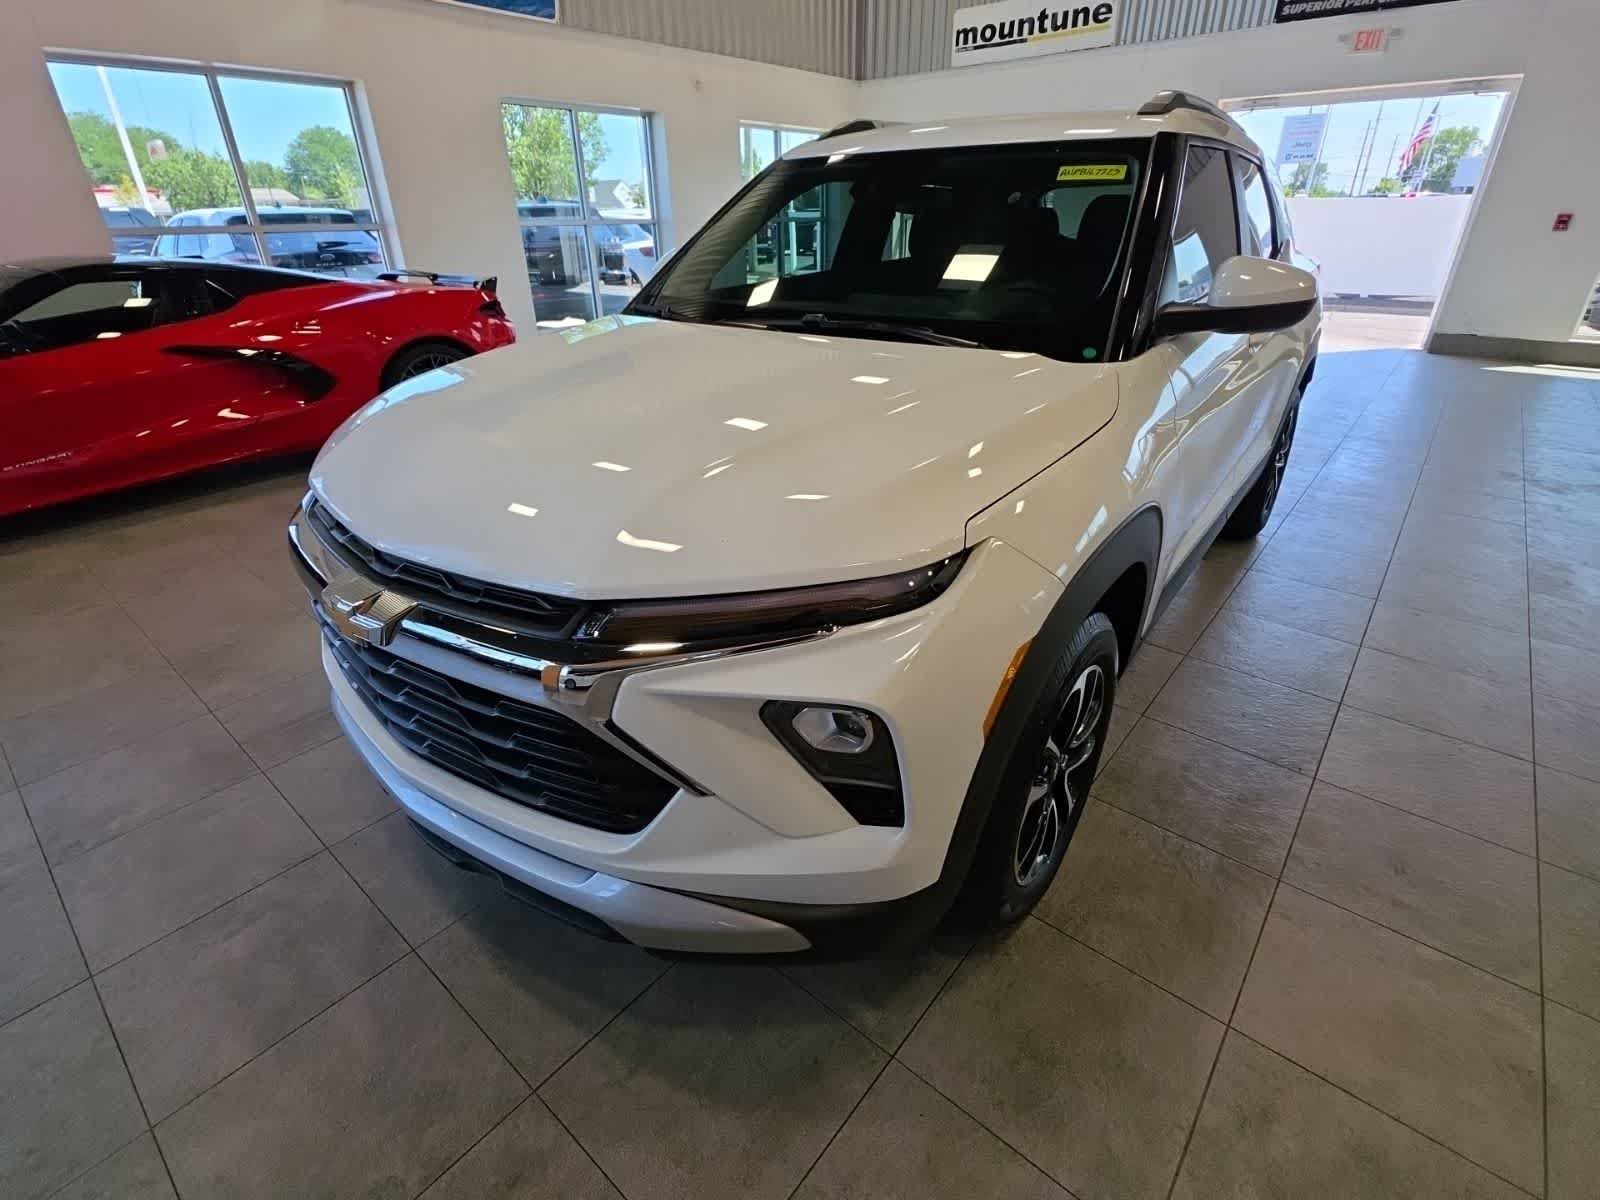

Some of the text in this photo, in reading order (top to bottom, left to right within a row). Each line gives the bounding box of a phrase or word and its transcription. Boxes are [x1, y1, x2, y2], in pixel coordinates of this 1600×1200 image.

[1281, 0, 1342, 15] SUPERIOR
[955, 2, 1113, 47] mountune
[1354, 31, 1382, 49] EXIT
